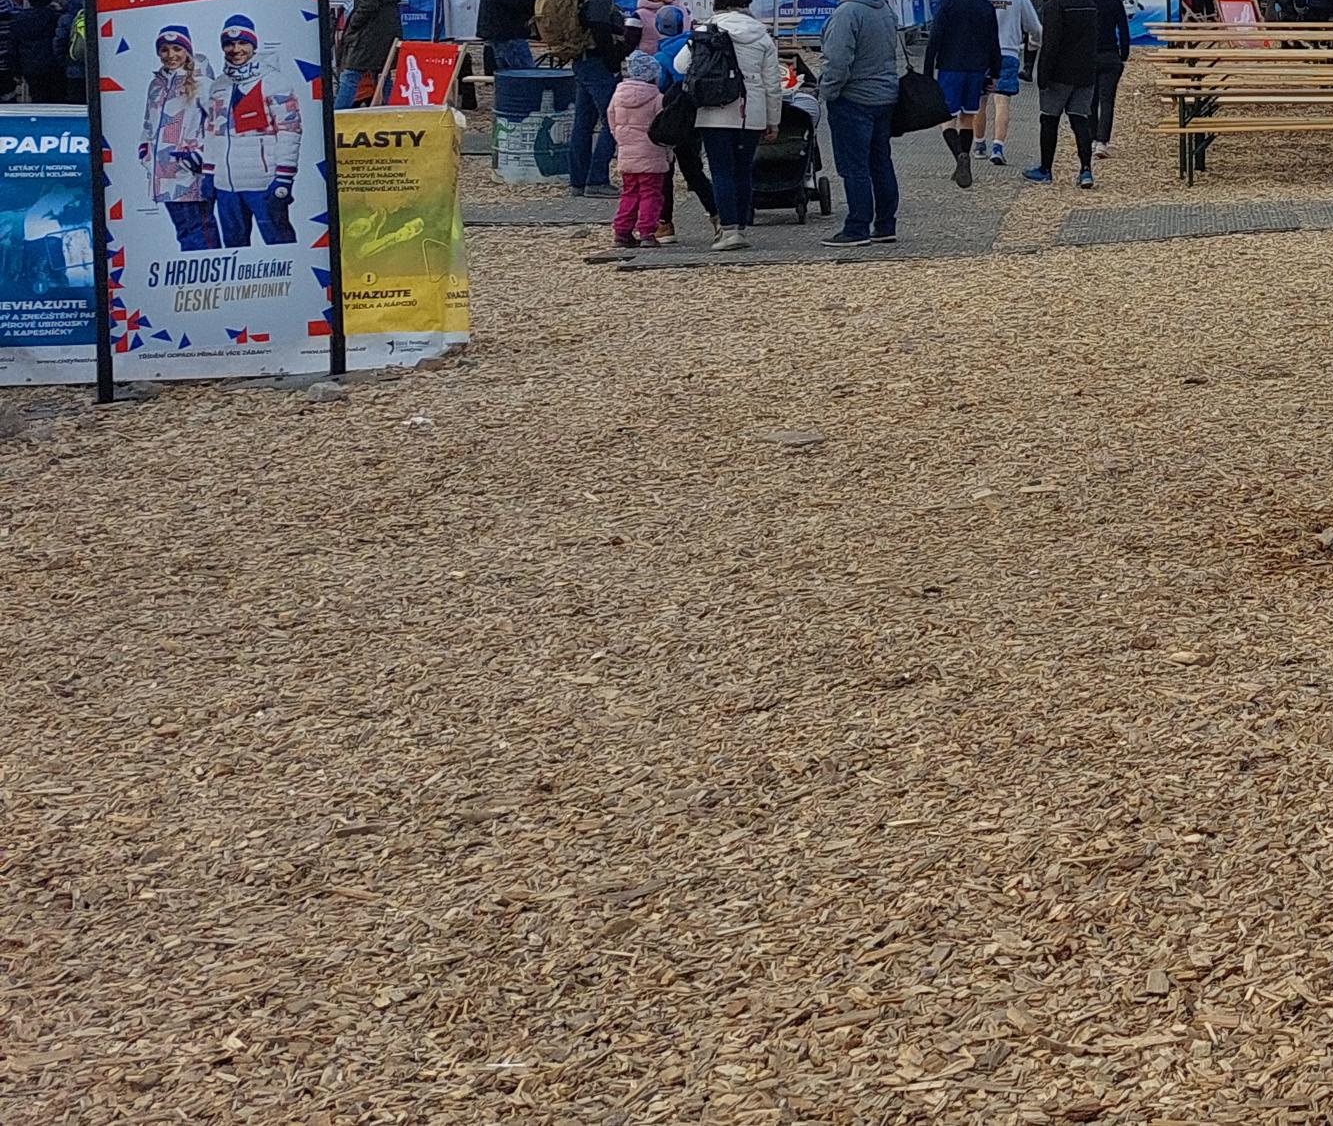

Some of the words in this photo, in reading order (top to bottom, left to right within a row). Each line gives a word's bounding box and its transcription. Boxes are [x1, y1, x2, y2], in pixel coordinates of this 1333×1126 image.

[0, 131, 90, 154] PAPÍR
[336, 130, 427, 149] LASTY
[148, 262, 160, 288] S
[164, 250, 239, 287] HRDOSTÍ
[237, 258, 294, 281] OBLÉKÁME
[174, 282, 222, 313] ČESKÉ
[223, 281, 292, 303] OLYMPIONIKY
[343, 289, 412, 301] VHAZUJTE
